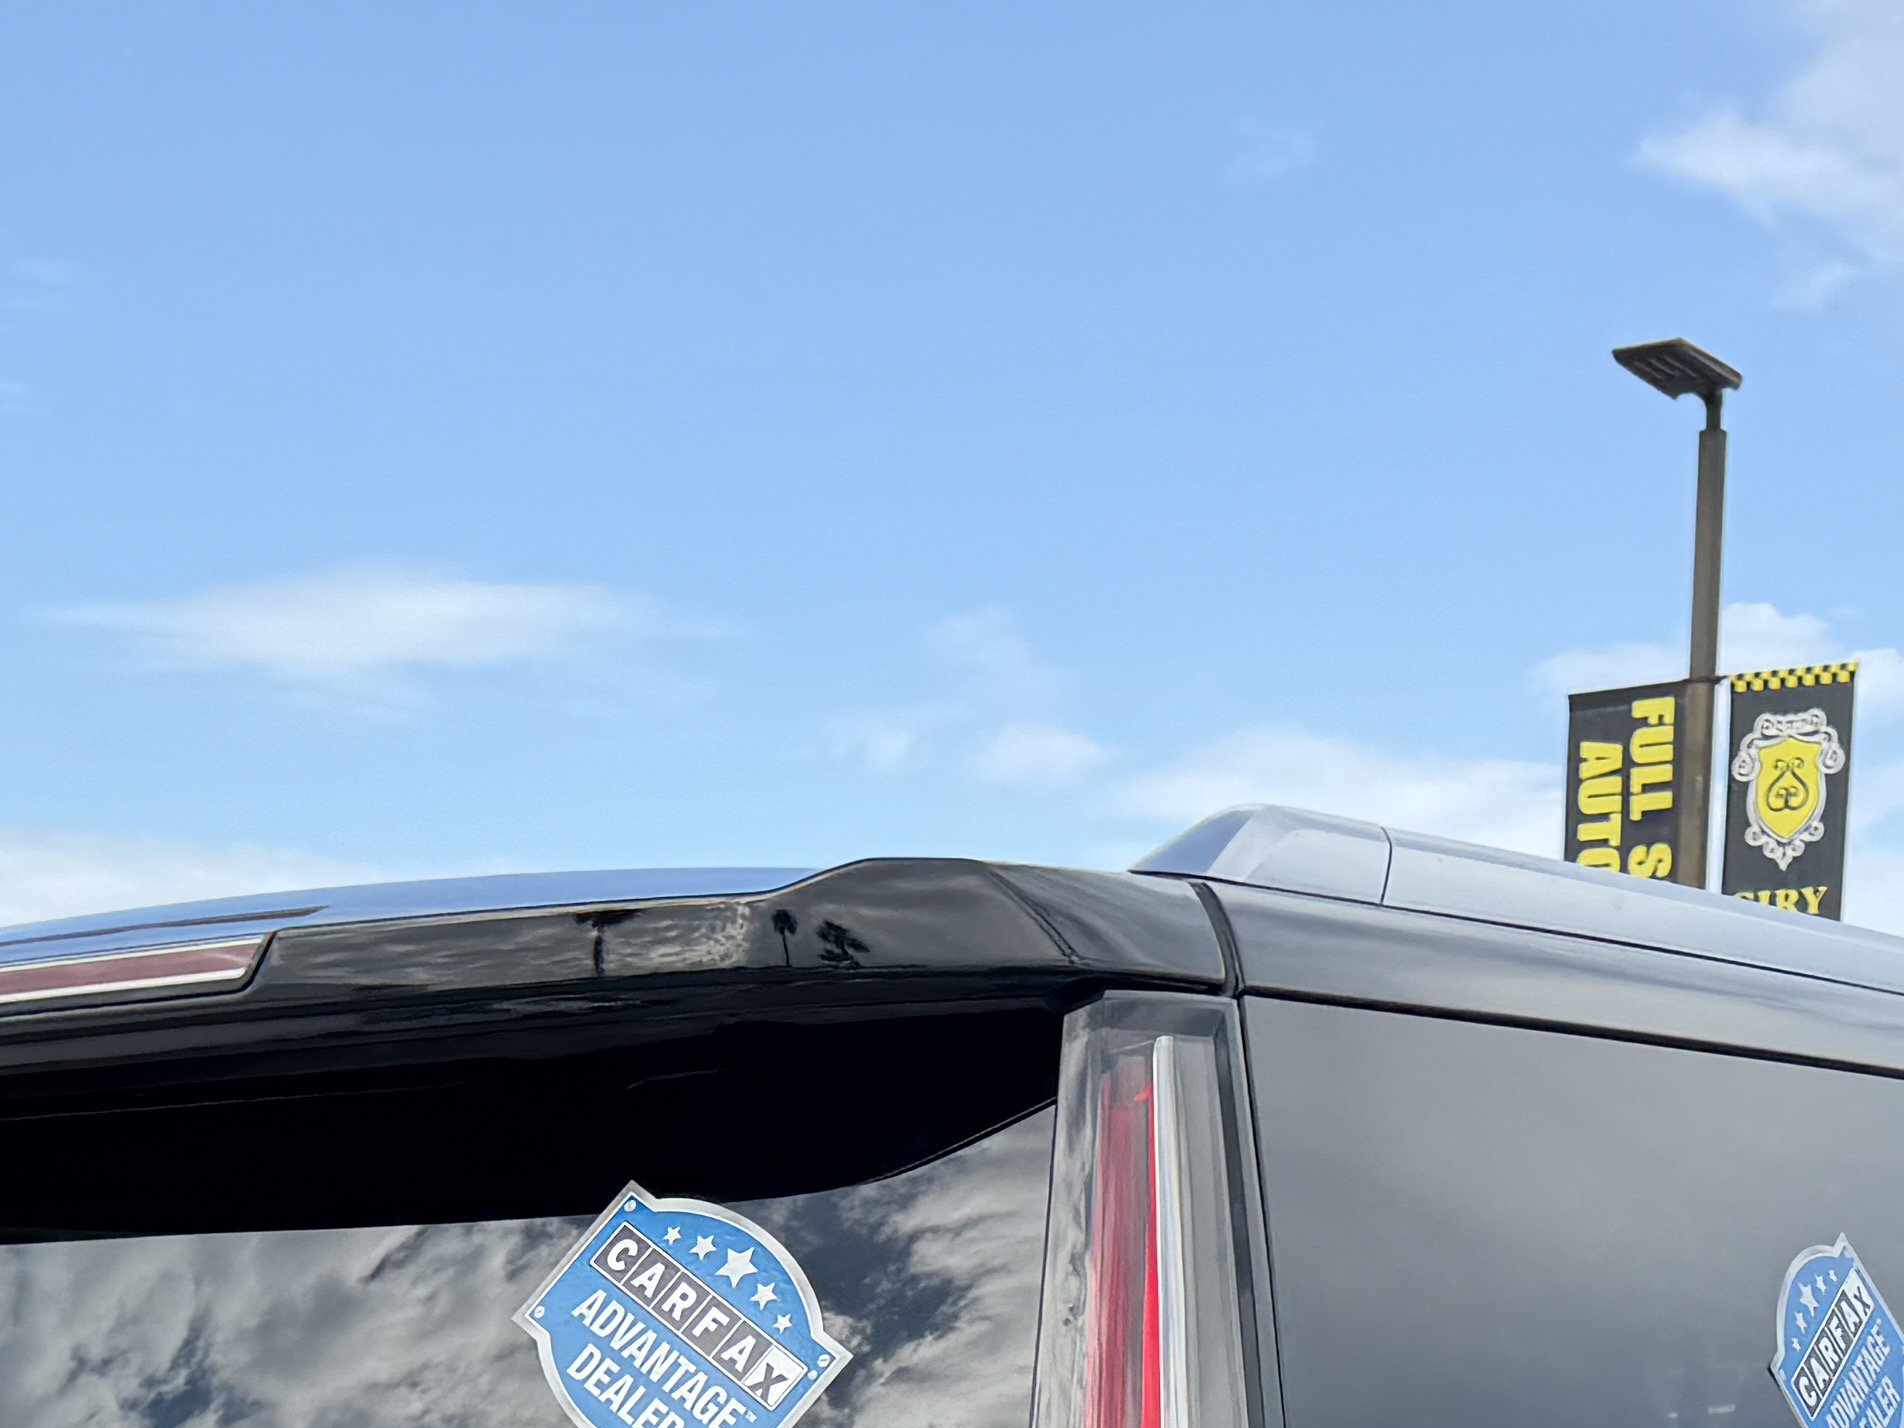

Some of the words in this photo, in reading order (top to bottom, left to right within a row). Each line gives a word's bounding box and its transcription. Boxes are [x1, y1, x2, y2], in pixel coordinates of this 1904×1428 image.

[1629, 696, 1676, 822] FULL
[605, 1237, 790, 1406] CARFAX
[1797, 1285, 1872, 1408] CARFAX
